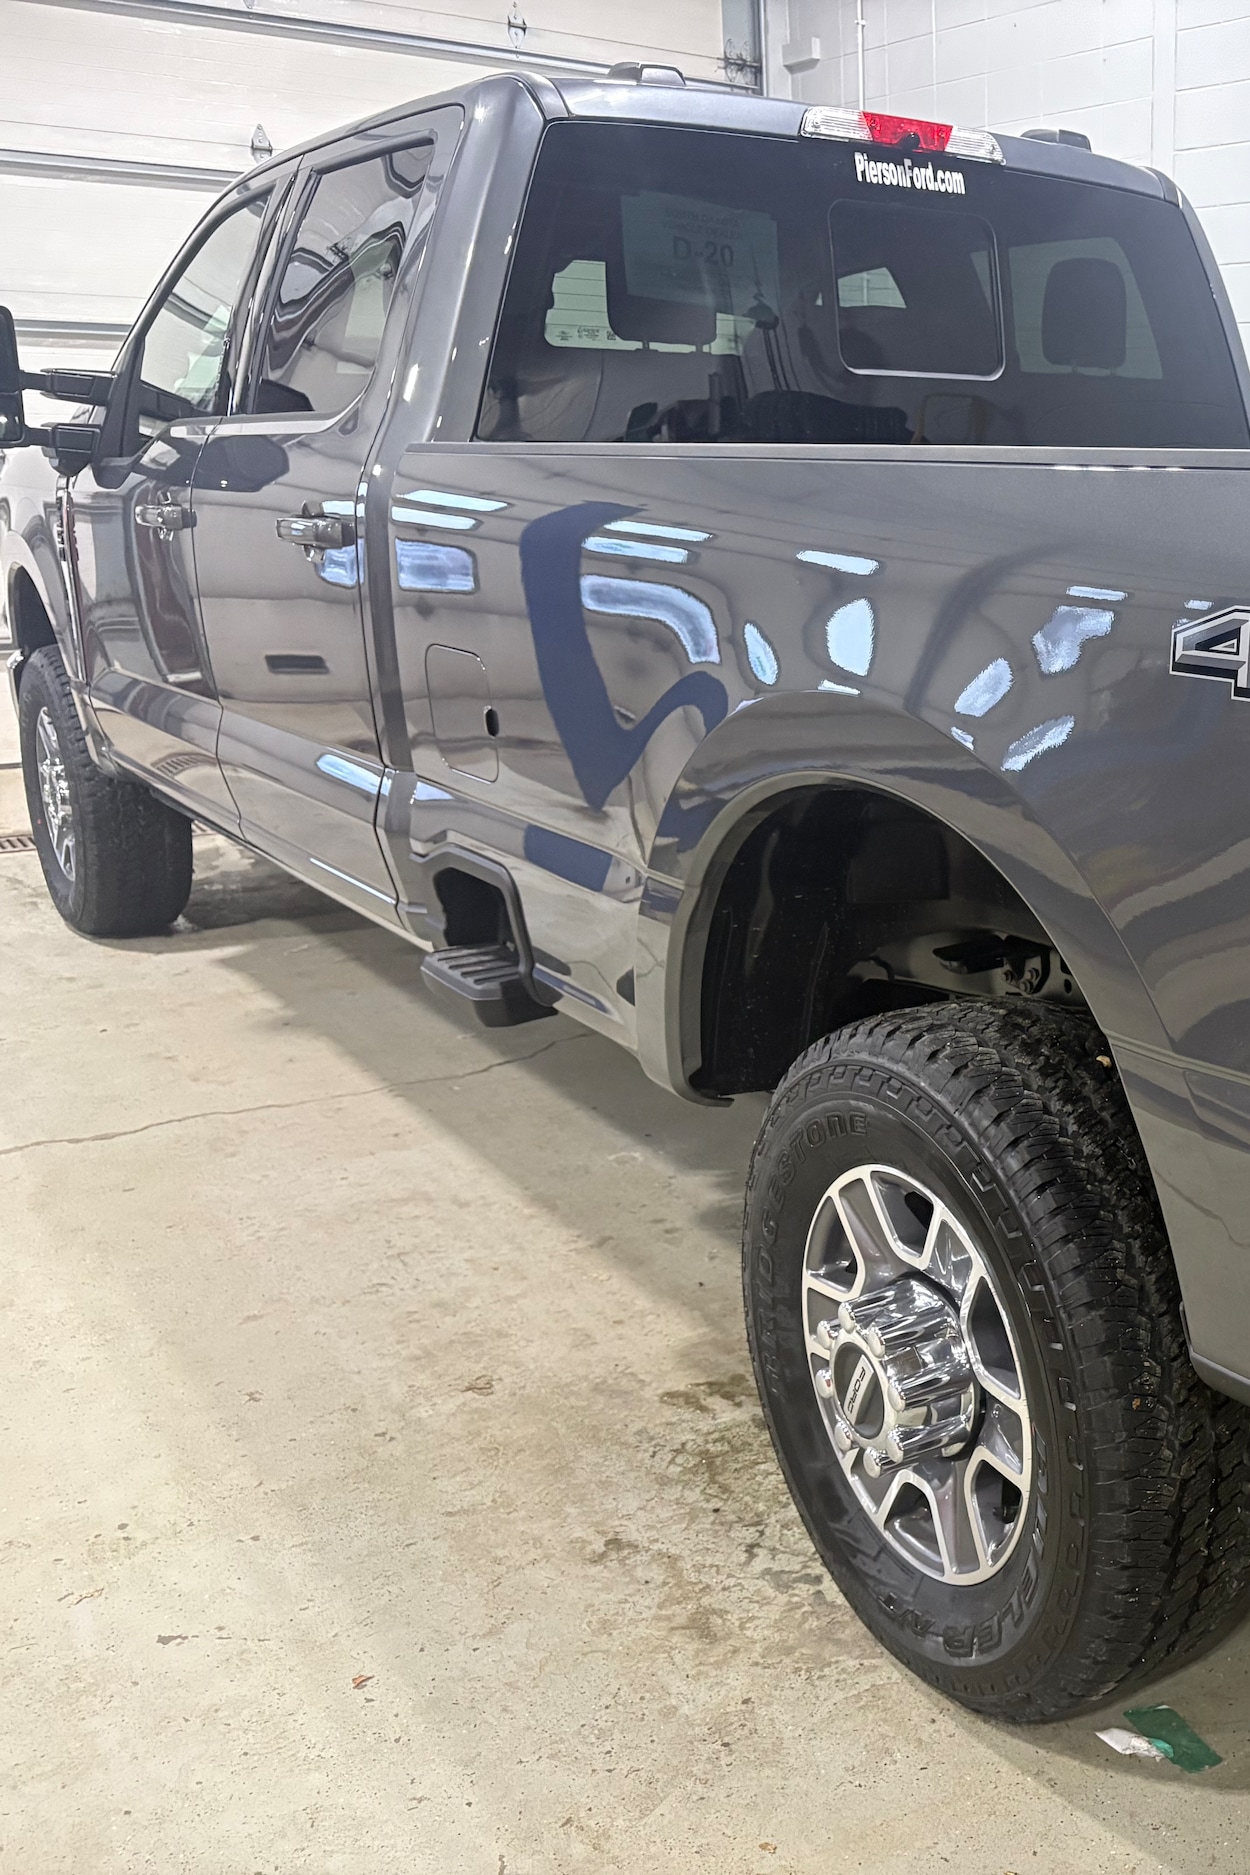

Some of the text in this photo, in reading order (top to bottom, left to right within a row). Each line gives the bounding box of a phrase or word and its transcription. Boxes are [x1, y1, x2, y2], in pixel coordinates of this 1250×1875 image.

[854, 152, 966, 194] PiersonFord.com
[672, 235, 735, 267] D-20
[756, 1110, 868, 1398] BRIDGESTONE
[846, 1365, 867, 1415] FORD
